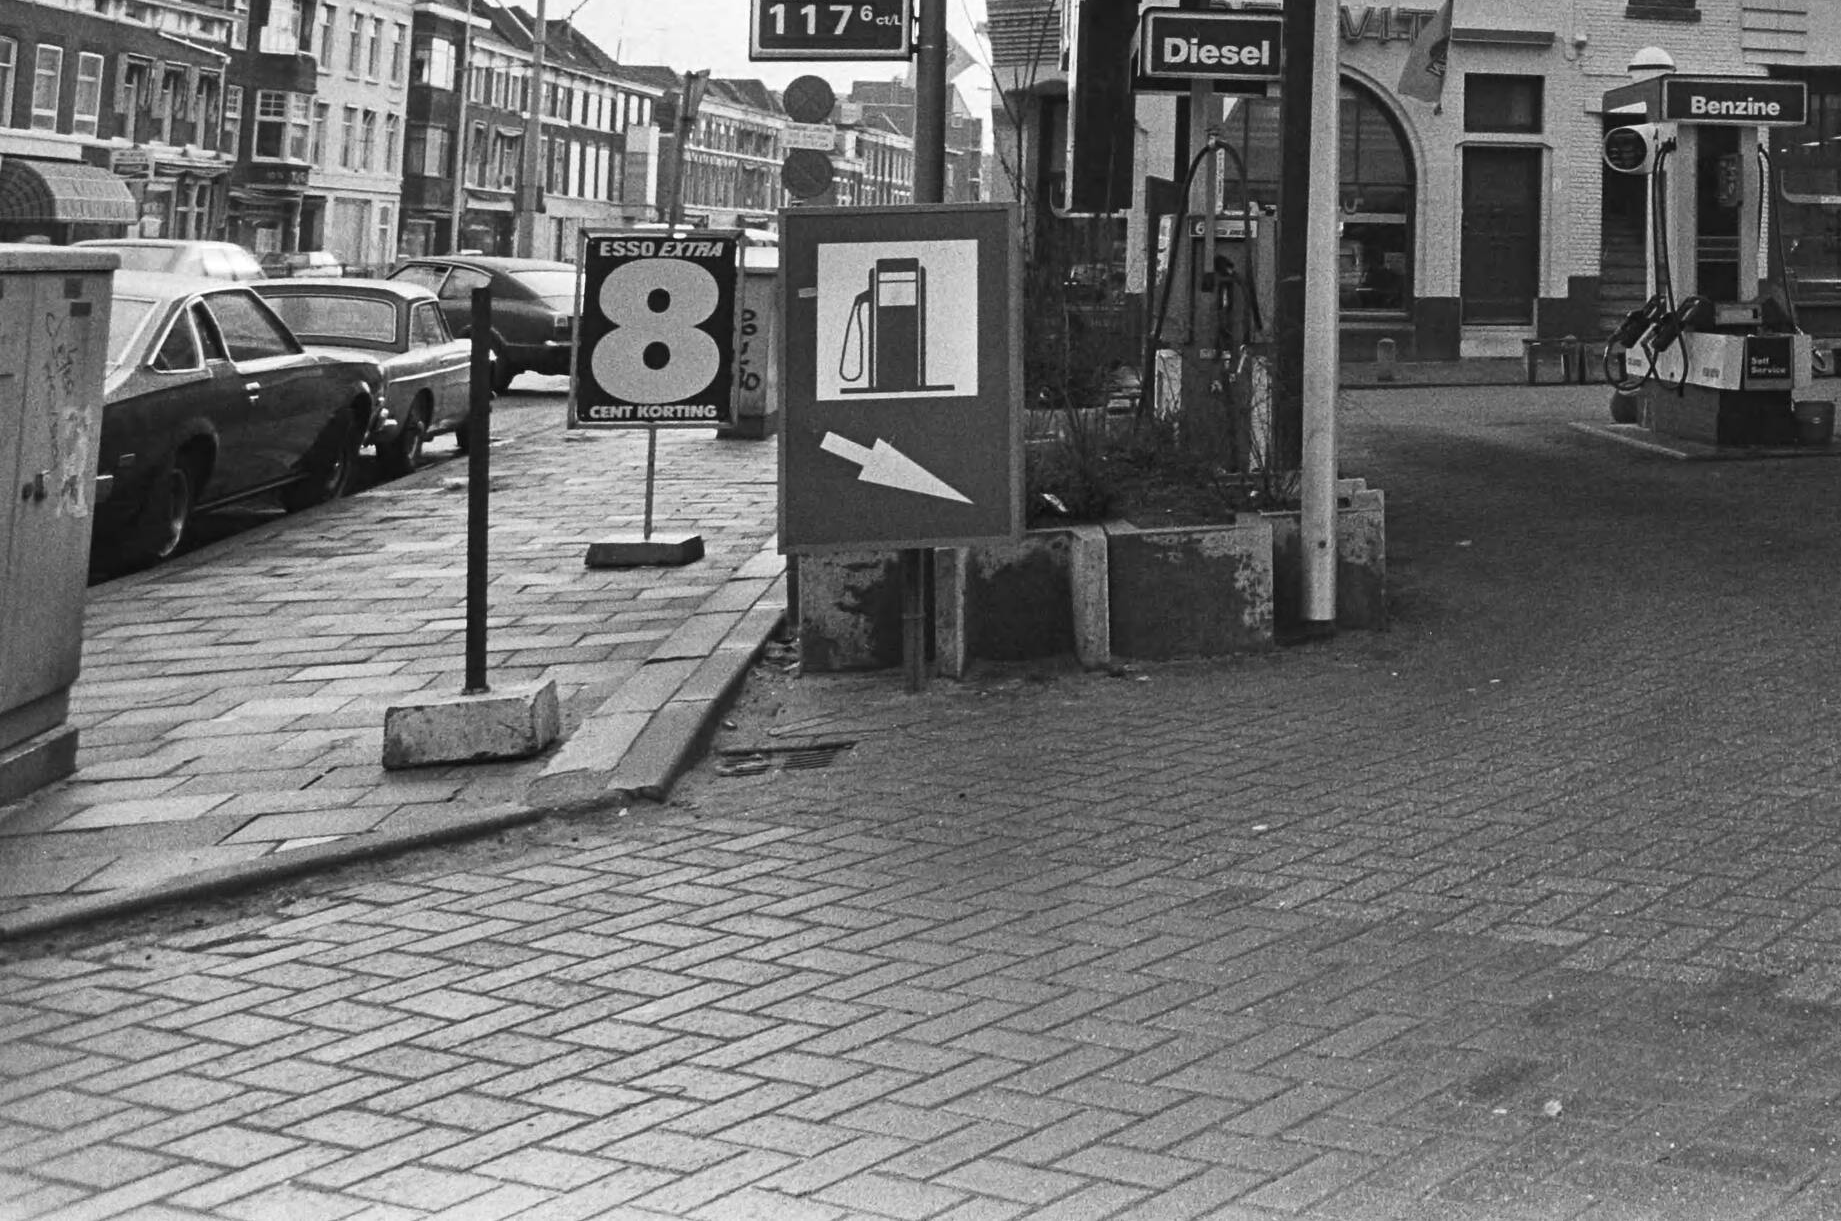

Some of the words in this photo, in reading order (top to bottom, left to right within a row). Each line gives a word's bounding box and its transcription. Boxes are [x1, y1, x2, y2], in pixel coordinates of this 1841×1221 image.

[1163, 36, 1270, 66] Diesel
[1690, 95, 1780, 116] Benzine
[600, 240, 655, 257] ESSO
[658, 241, 724, 258] EXTRA
[591, 258, 720, 404] 8
[1750, 356, 1770, 366] Self
[1750, 365, 1787, 375] Service
[589, 405, 633, 419] CENT
[637, 405, 718, 419] KORTING
